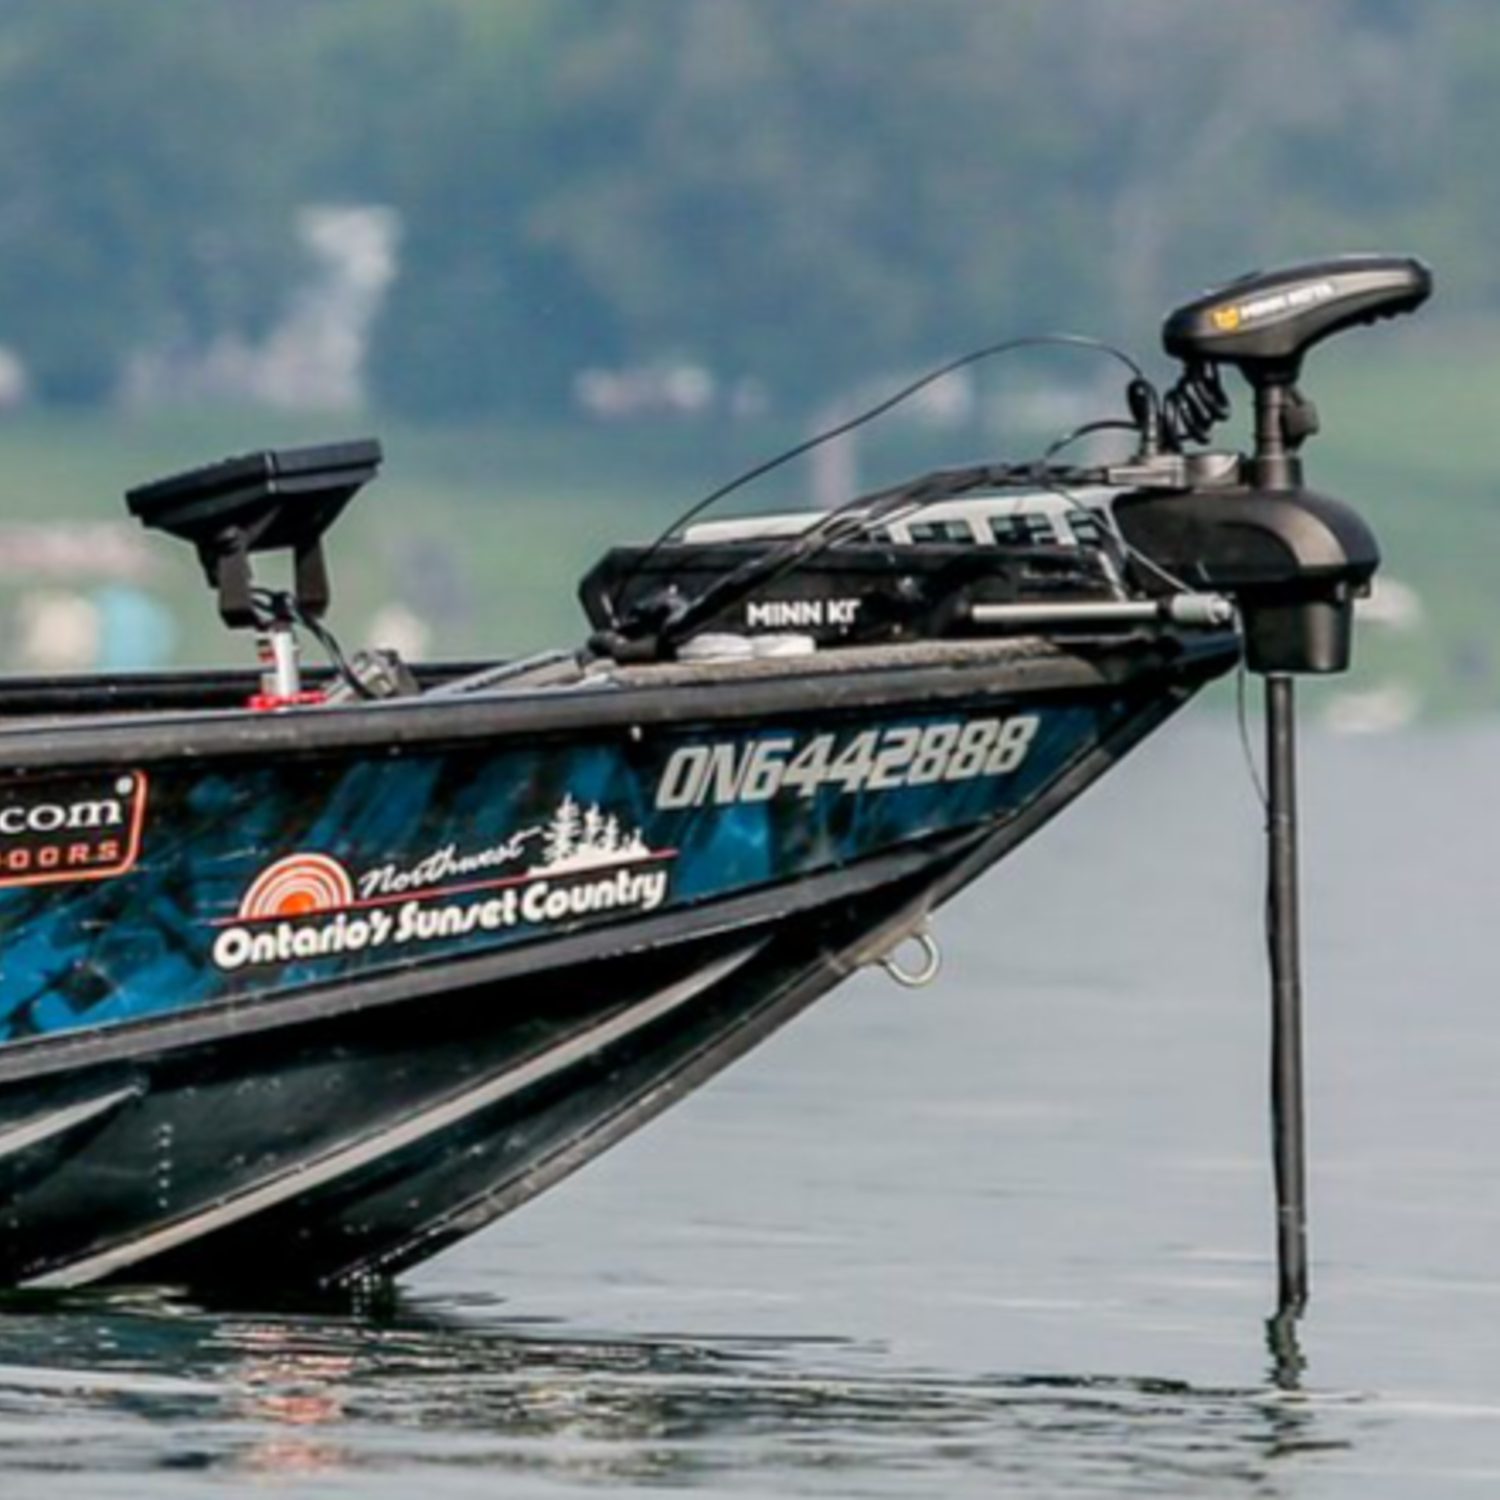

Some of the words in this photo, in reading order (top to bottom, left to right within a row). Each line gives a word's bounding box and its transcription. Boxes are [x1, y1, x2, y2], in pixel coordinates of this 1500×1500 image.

[746, 601, 822, 627] MINN
[655, 714, 1041, 810] ON6442888
[358, 824, 543, 899] Northwest
[212, 912, 395, 970] Ontario's
[398, 888, 515, 944] Sunset
[520, 870, 668, 924] Country
